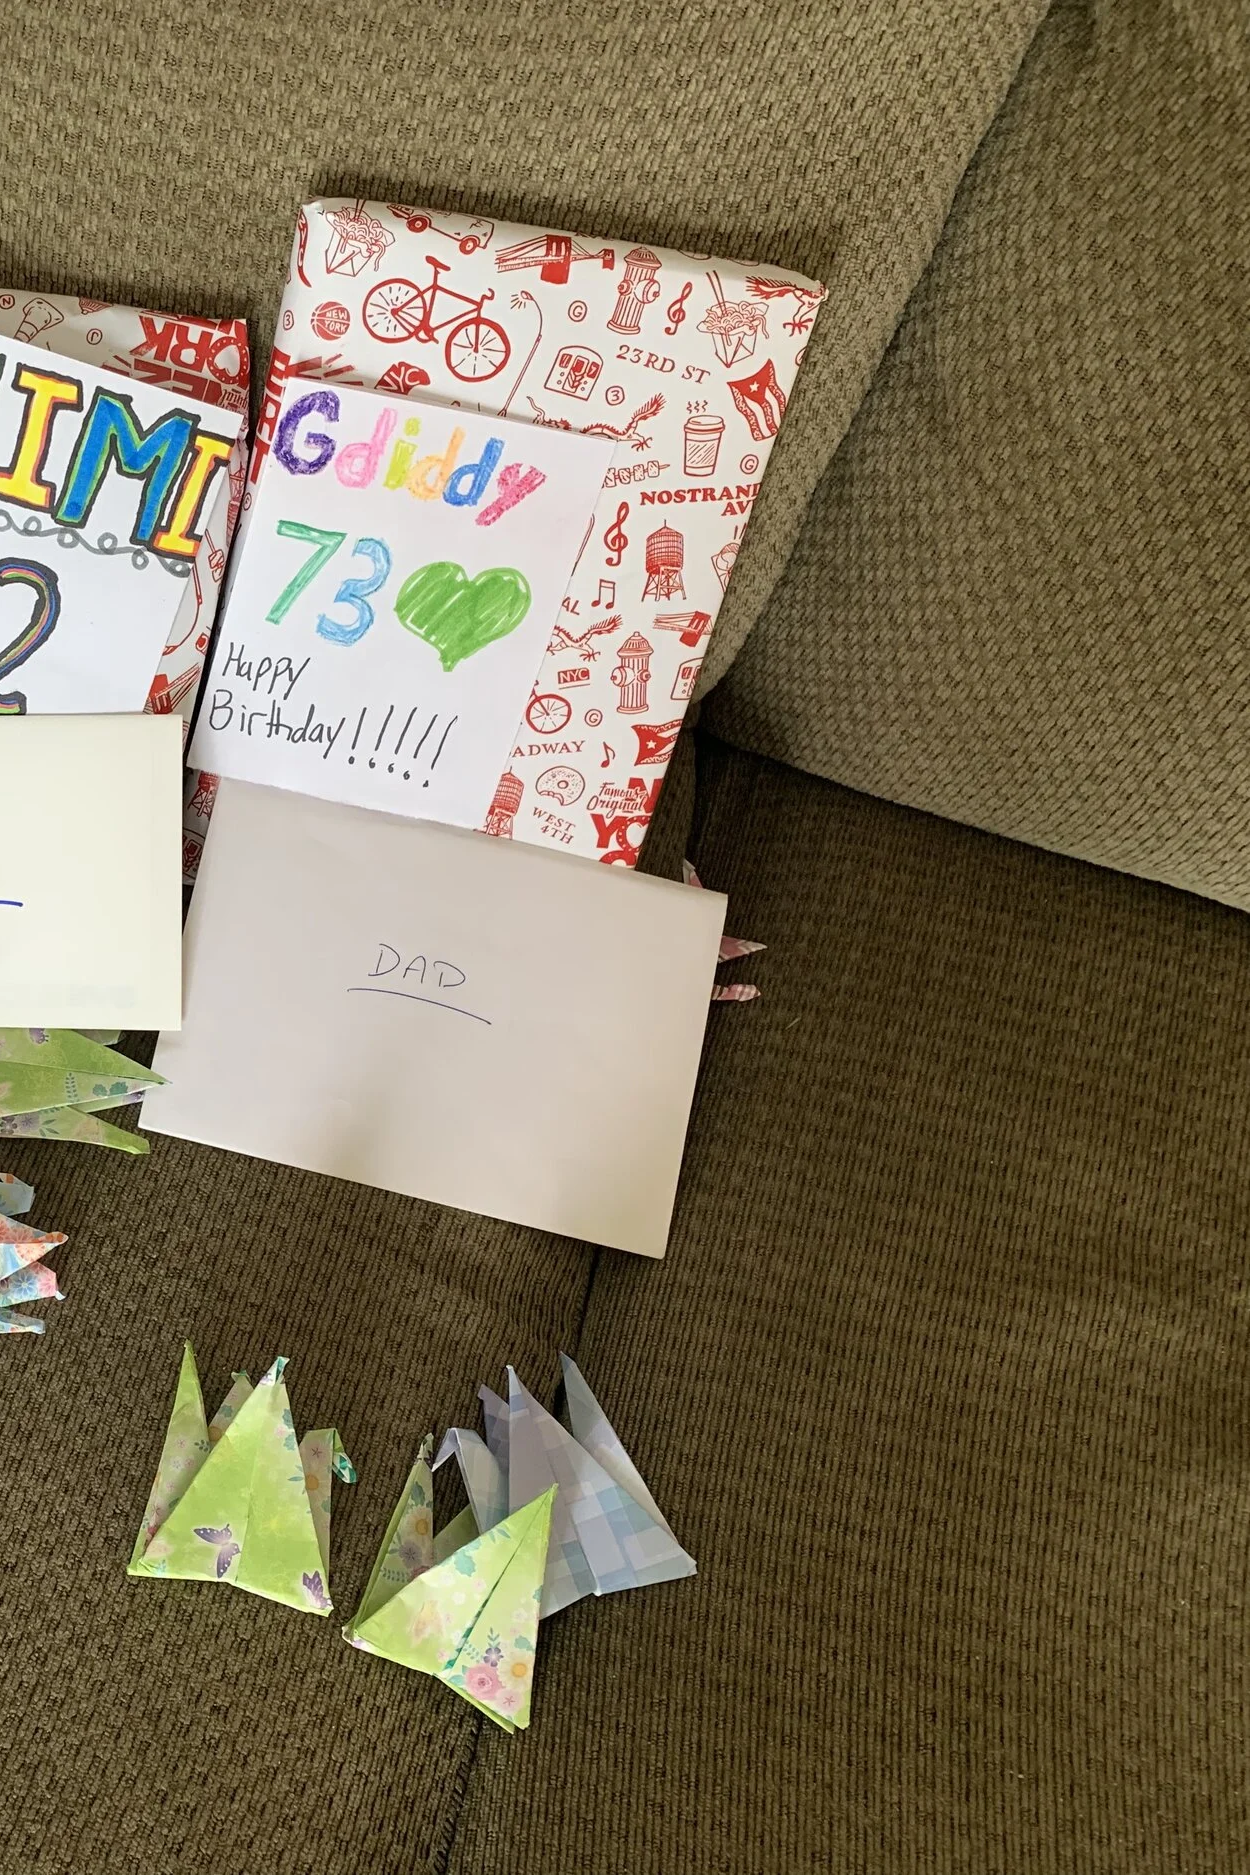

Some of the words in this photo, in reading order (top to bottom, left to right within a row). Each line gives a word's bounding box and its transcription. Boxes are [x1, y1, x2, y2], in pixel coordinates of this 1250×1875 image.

[323, 319, 348, 333] YORK
[325, 309, 348, 319] NEW
[615, 345, 676, 373] 23RD
[681, 364, 711, 385] ST
[273, 389, 548, 527] Gdiddy
[265, 519, 391, 648] 73
[222, 641, 311, 700] Happy
[560, 669, 590, 683] NYC
[512, 740, 585, 757] ADWAY
[599, 781, 647, 800] Famous
[586, 795, 647, 819] Original
[532, 806, 576, 833] WEST
[541, 824, 574, 845] 4TH
[368, 943, 466, 988] DAD
